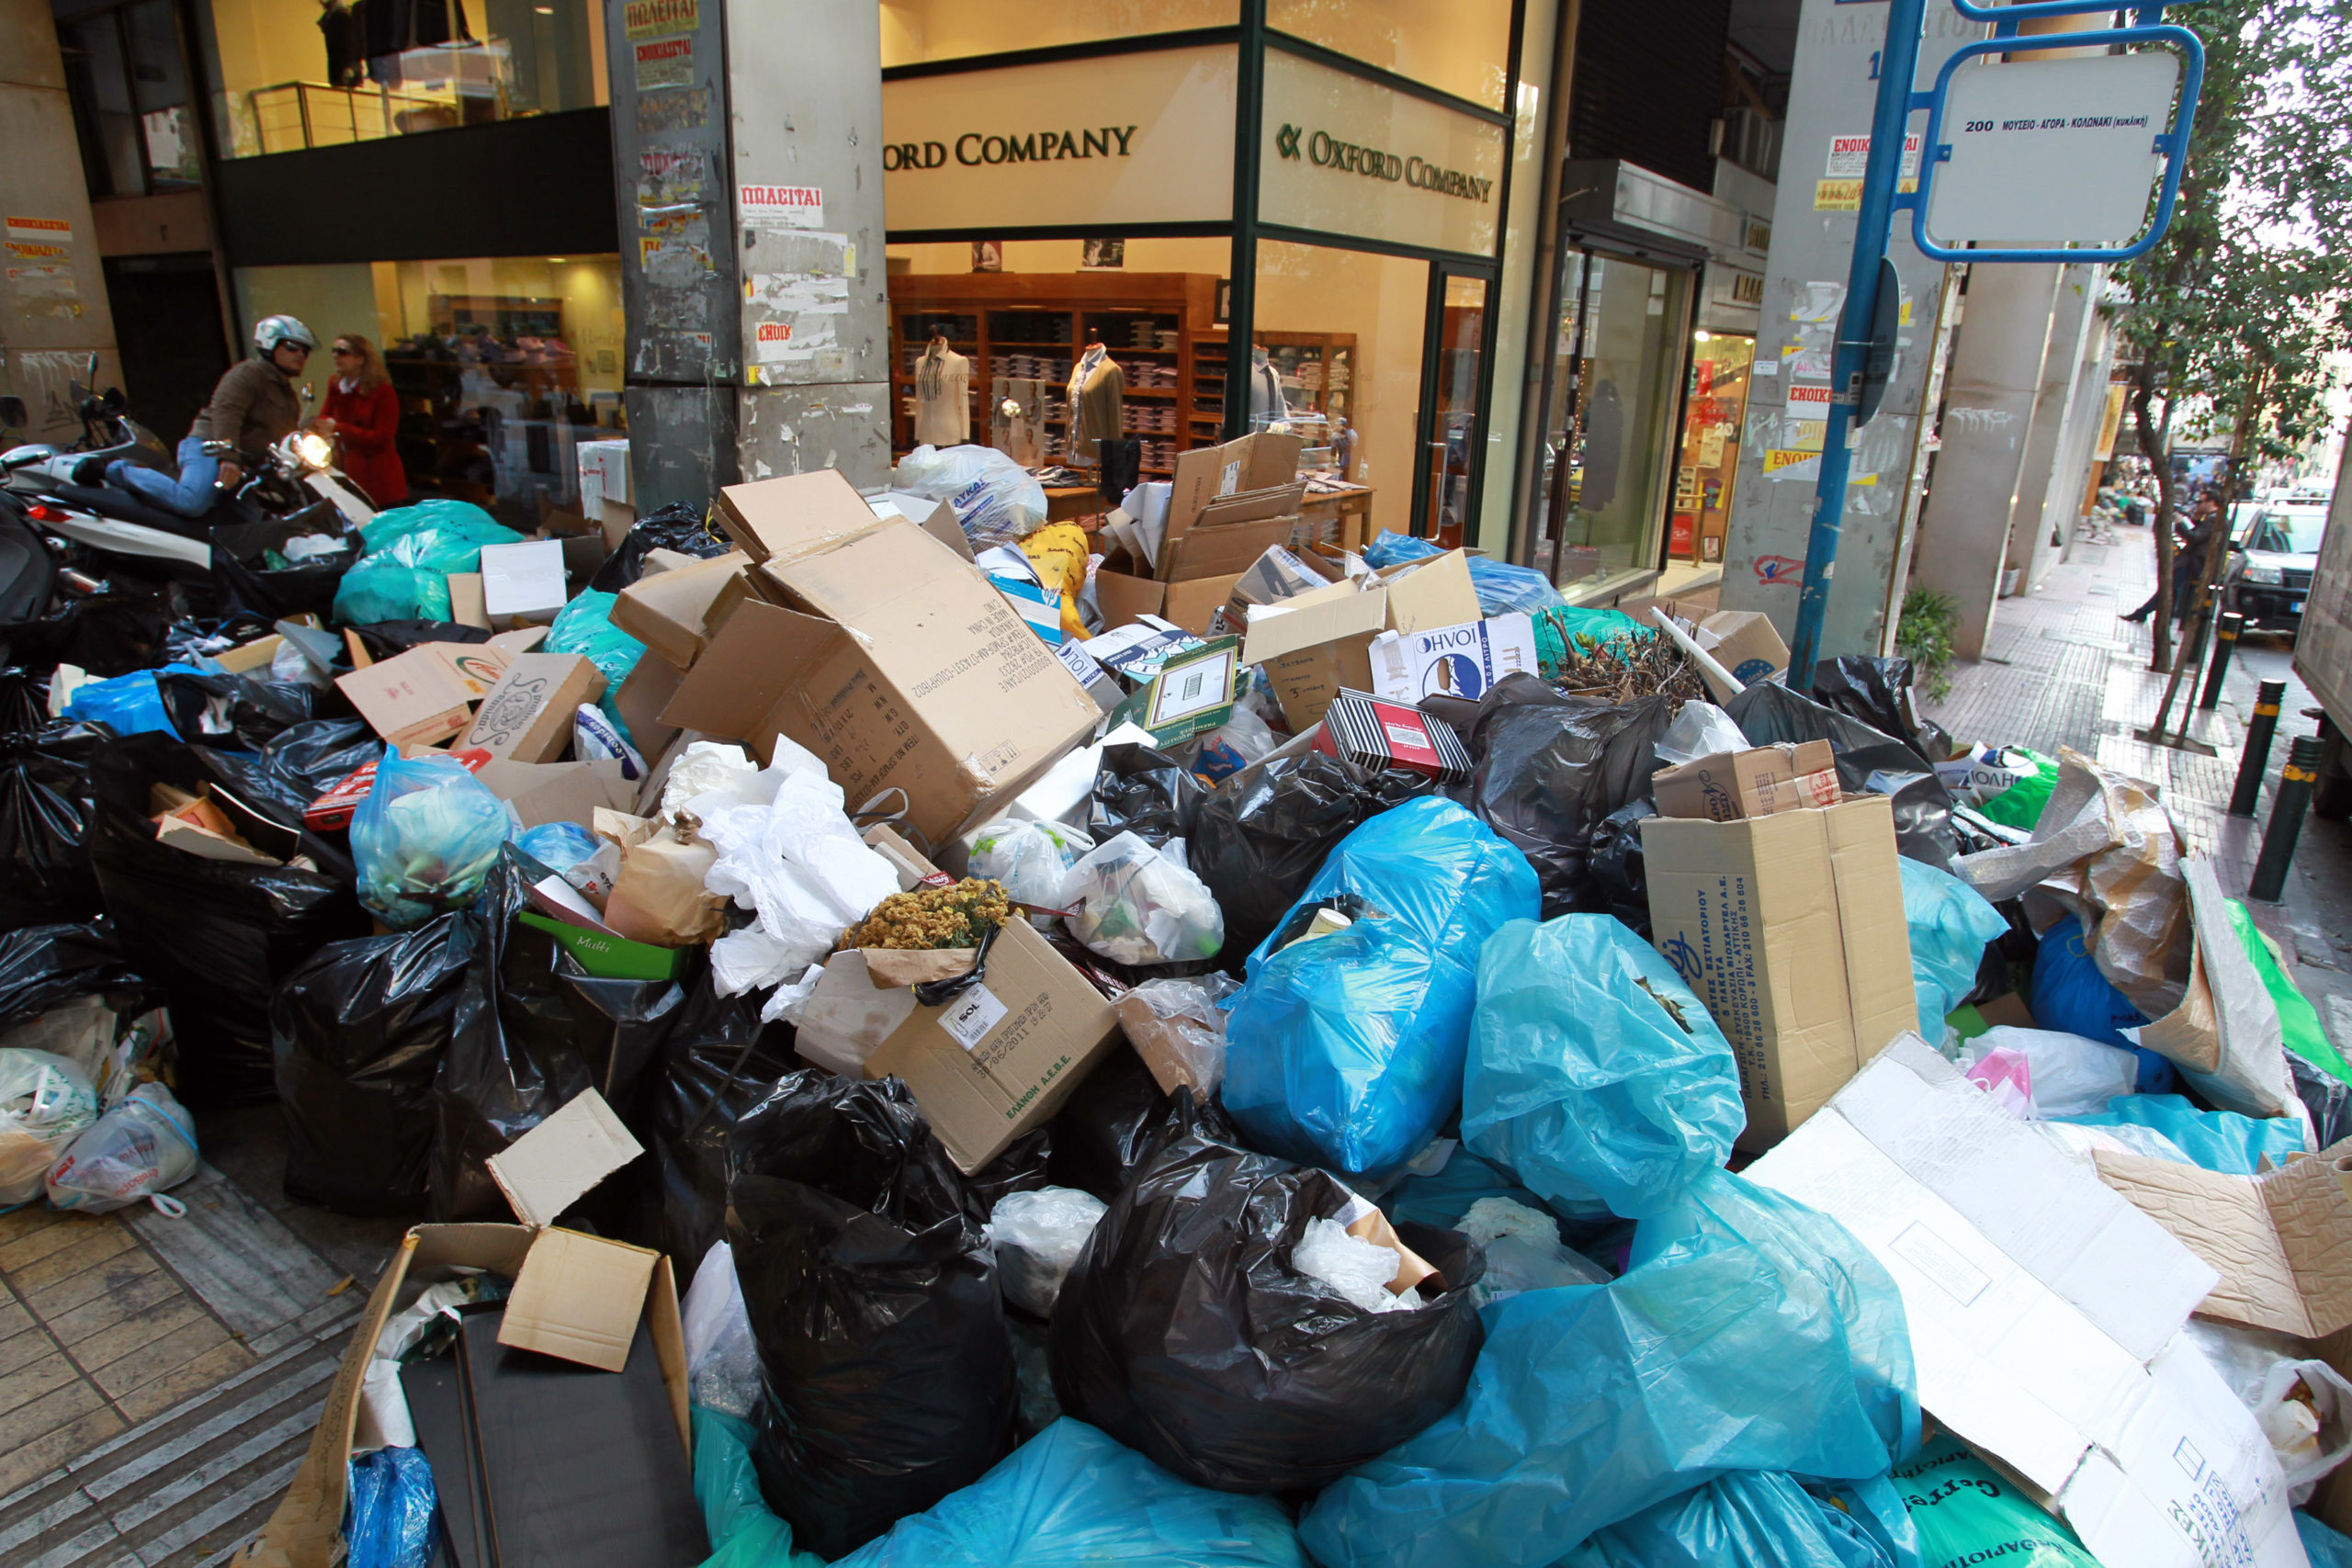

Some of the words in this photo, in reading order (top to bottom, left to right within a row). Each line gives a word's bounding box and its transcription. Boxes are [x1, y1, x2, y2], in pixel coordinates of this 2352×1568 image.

[1965, 120, 1994, 132] 200
[2002, 119, 2035, 130] ΜΟΥΣΕΙΟ
[2040, 118, 2065, 130] ΑΓΟΡΑ
[2071, 117, 2112, 128] ΚΟΛΩΝΑΚΙ
[741, 186, 821, 207] ΠΩΛΕΙΤΑΙ
[1044, 589, 1056, 605] hp
[1481, 637, 1491, 661] ΛΙΤΡΟ
[1718, 875, 1727, 898] Α.Ε.
[1696, 888, 1713, 970] ΕΣΤΙΑΤΟΡΙΟΥ
[1720, 901, 1735, 966] ΒΙΟΧΑΡΤΕΛ
[1729, 910, 1742, 956] ΑΤΤΙΚΗΣ
[1741, 931, 1751, 950] 210
[577, 936, 610, 953] Multi
[1744, 953, 1755, 977] FAX:
[1715, 955, 1728, 1003] ΠΑΚΕΤΑ
[1736, 966, 1748, 1009] ΚΟΡΩΠΙ
[959, 1003, 980, 1022] SOL
[1756, 1051, 1766, 1070] 210
[1006, 1086, 1040, 1120] ΕΛΑΝΘΗ
[1041, 1055, 1071, 1085] Α.Ε.Β.Ε.
